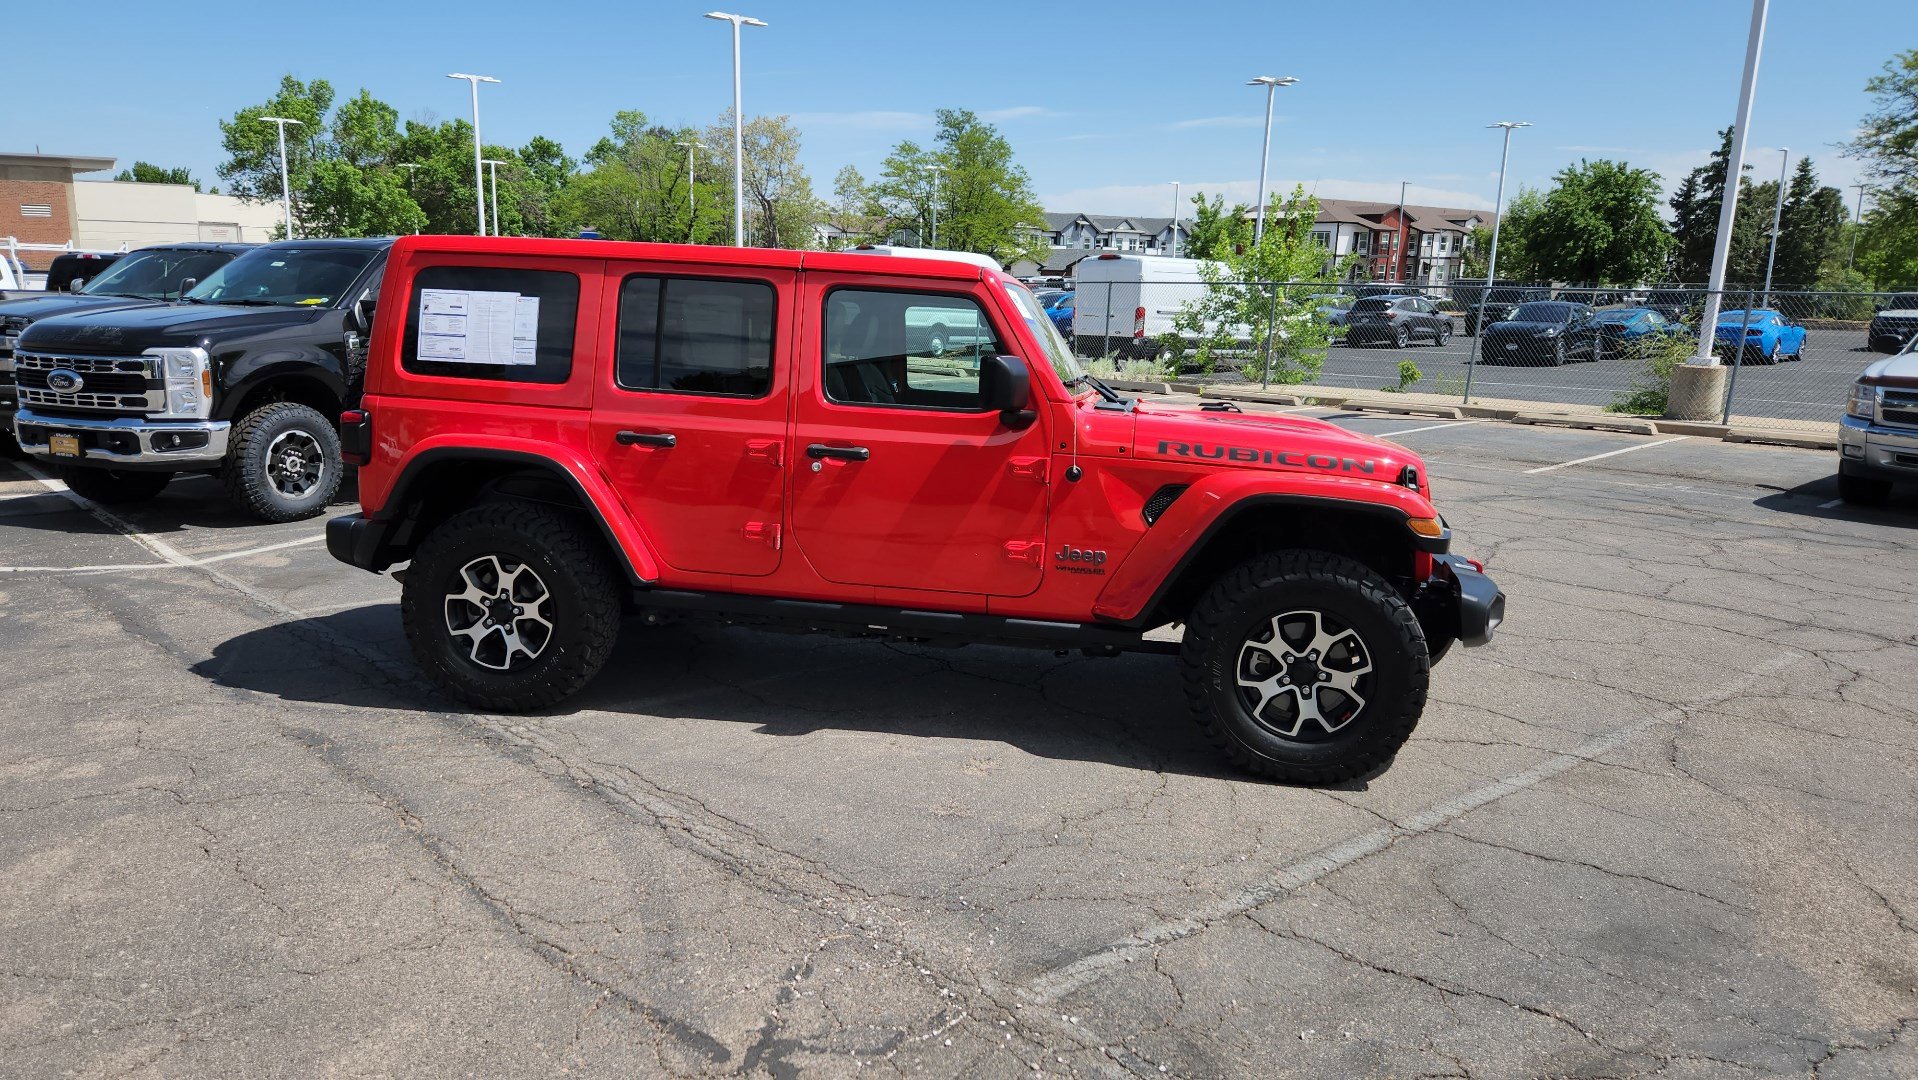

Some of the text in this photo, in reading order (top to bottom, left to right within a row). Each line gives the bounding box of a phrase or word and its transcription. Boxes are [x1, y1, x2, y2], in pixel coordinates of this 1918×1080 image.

[1157, 440, 1375, 474] RUBICON
[1055, 544, 1107, 566] Jeep
[1055, 565, 1106, 573] WRANGLER
